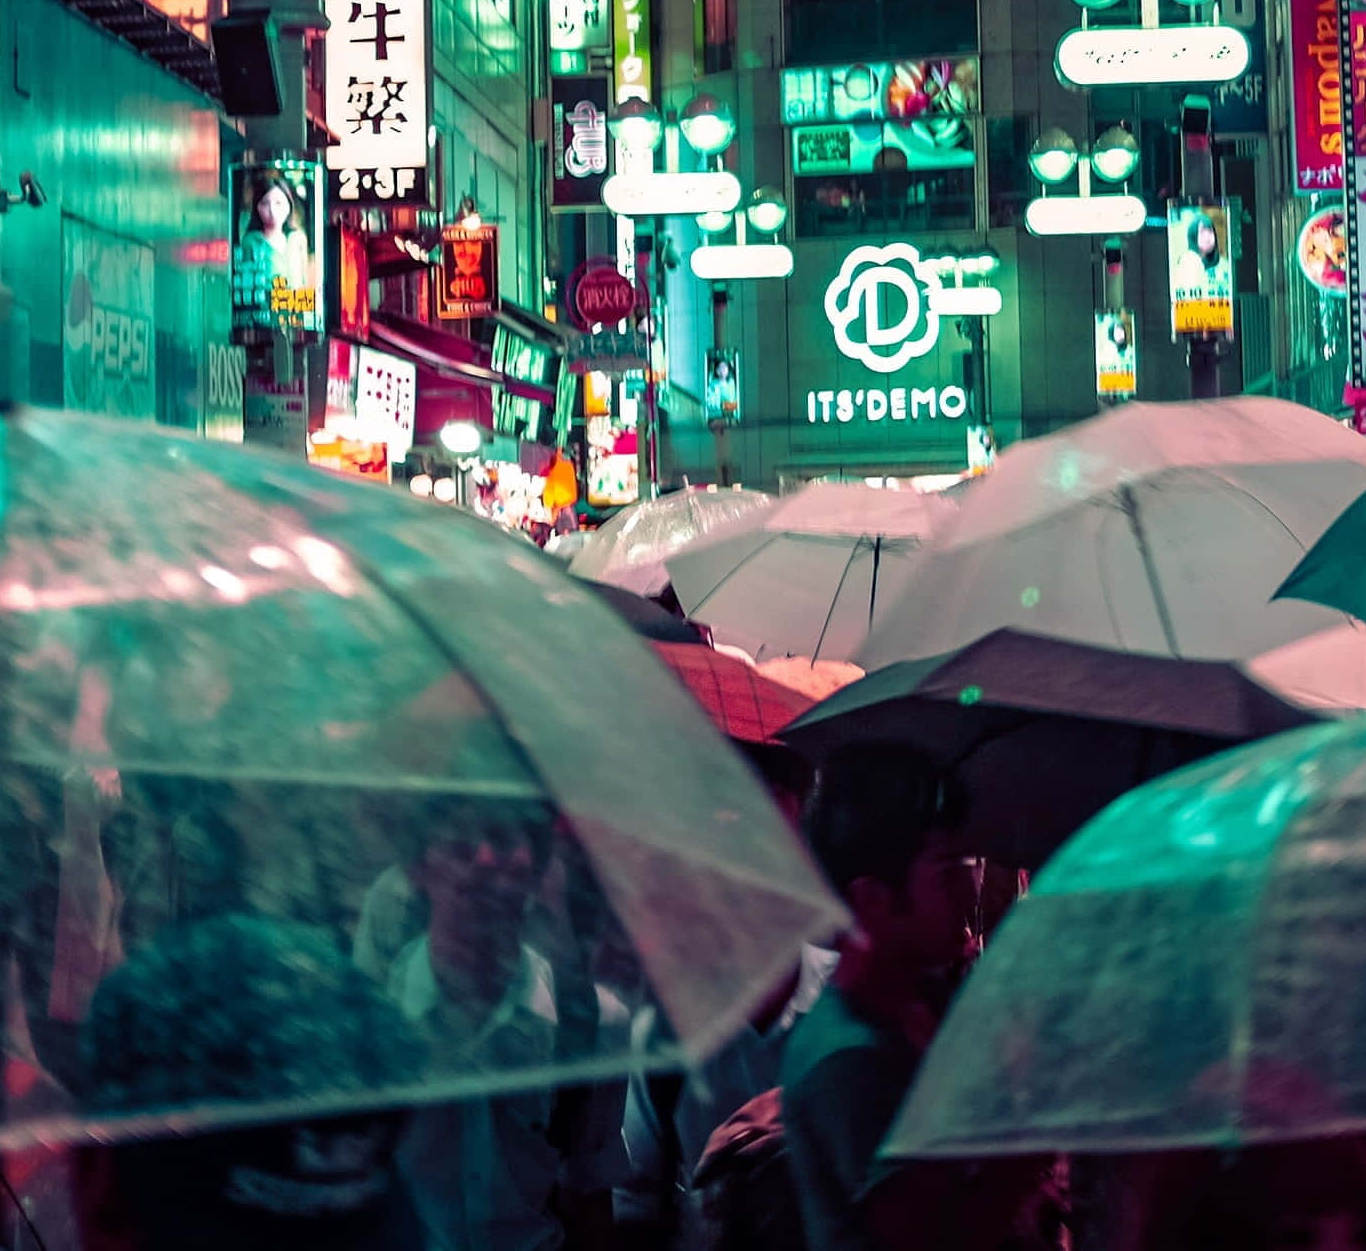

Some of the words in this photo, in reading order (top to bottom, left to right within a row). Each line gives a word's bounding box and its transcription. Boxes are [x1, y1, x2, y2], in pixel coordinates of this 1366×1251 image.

[346, 1, 409, 135] 牛繁
[90, 305, 150, 380] PEPSI
[207, 341, 247, 408] BOSS
[807, 385, 967, 424] ITS'DEMO
